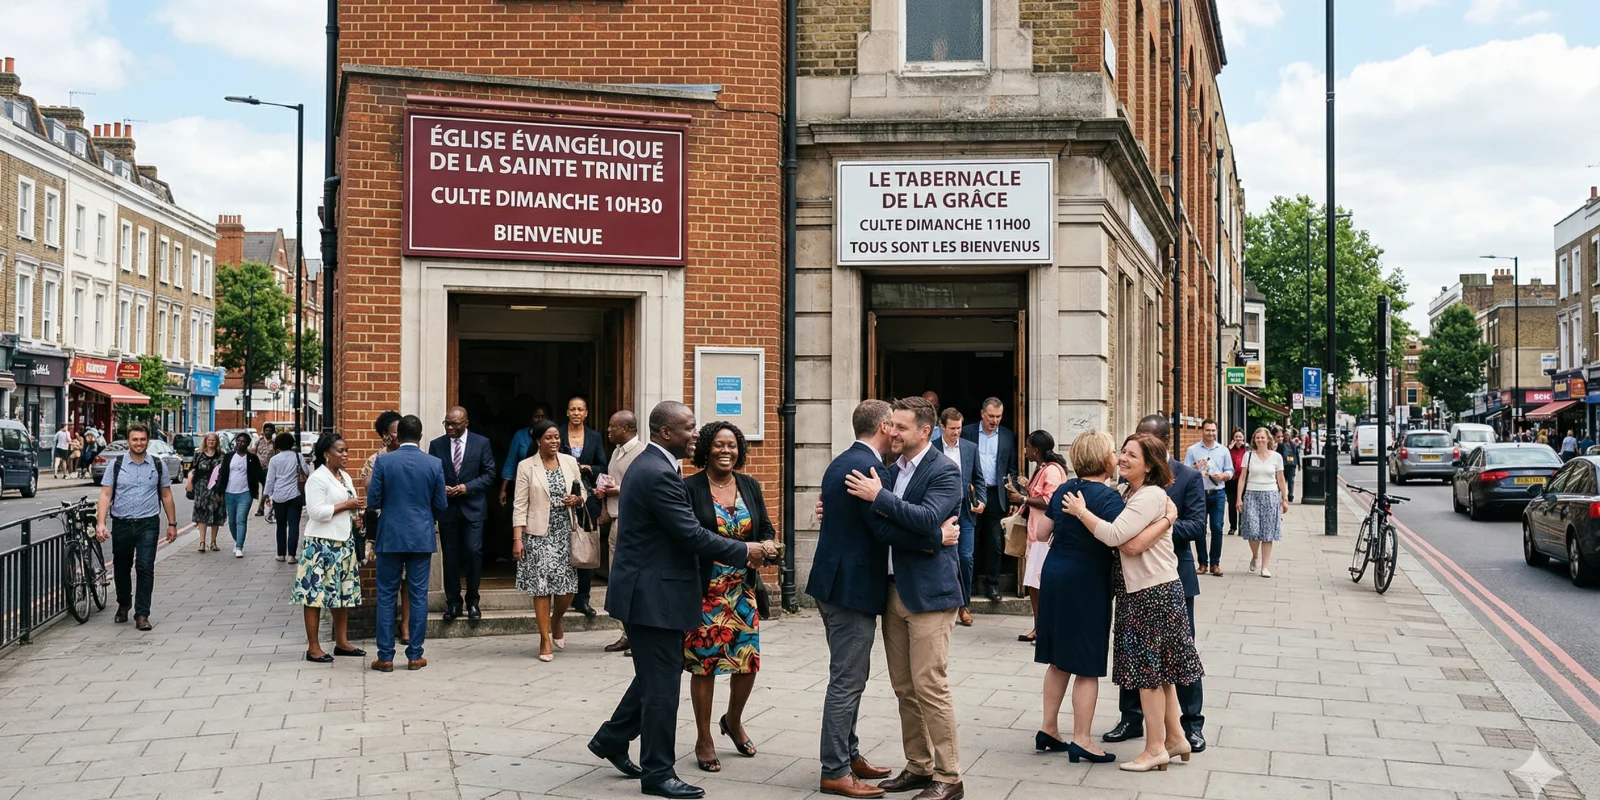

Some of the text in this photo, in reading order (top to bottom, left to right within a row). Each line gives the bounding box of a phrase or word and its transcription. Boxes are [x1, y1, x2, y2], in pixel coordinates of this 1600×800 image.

[431, 125, 664, 159] ÉGLISE ÉVANGÉLIQUE
[431, 152, 664, 182] DE LA SAINTE TRINITÉ
[870, 171, 1021, 187] LE TABERNACLE
[431, 187, 663, 214] CULTE DIMANCHE 10H30
[883, 188, 1008, 208] DE LA GRÂCE
[494, 224, 603, 245] BIENVENUE
[860, 218, 1031, 231] CULTE DIMANCHE 11H00
[850, 241, 1041, 253] TOUS SONT LES BIENVENUS
